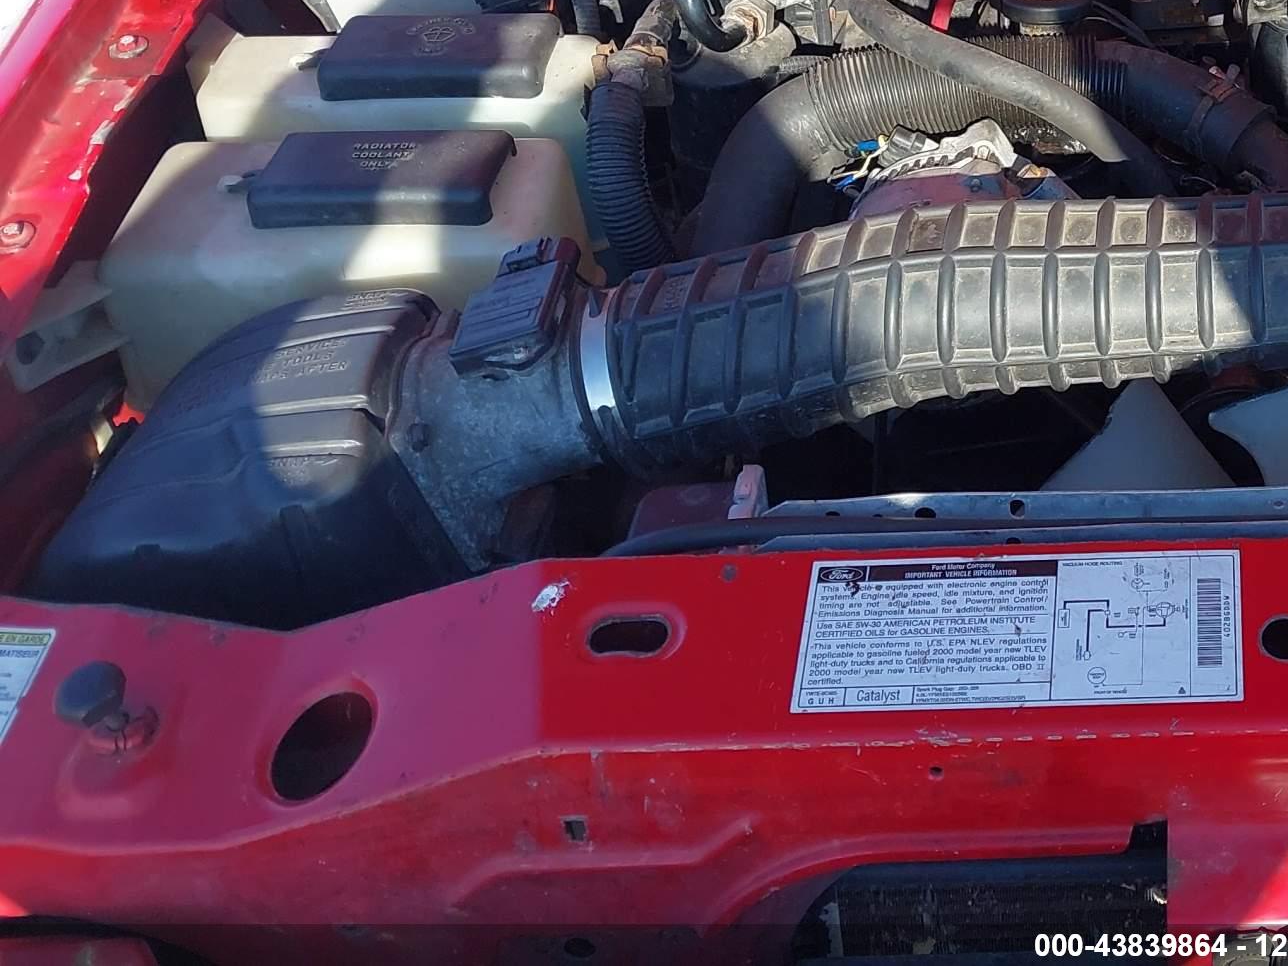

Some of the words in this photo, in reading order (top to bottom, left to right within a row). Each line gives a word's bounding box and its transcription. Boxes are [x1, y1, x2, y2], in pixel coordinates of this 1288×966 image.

[829, 570, 855, 580] Ford
[904, 571, 942, 579] IMPORTANT
[885, 582, 924, 591] equipped
[1021, 579, 1048, 587] control
[912, 590, 940, 599] speed,
[1019, 588, 1048, 596] ignition
[820, 602, 845, 610] timing
[1013, 595, 1048, 603] Control/
[864, 608, 904, 617] Diagnosis
[908, 606, 938, 614] Manual
[956, 605, 995, 613] additional
[999, 604, 1047, 612] information.
[835, 621, 853, 629] SAE
[883, 619, 931, 627] AMERICAN
[933, 618, 987, 626] PETROLEUM
[900, 627, 945, 635] GASOLINE
[19, 634, 46, 644] GARDE
[927, 639, 944, 647] U.S.
[949, 638, 966, 646] EPA
[970, 638, 995, 646] NLEV
[999, 637, 1047, 646] regulations
[811, 651, 853, 660] applicable
[867, 650, 902, 658] gasoline
[904, 648, 930, 656] fueled
[956, 647, 981, 655] model
[984, 647, 1001, 655] year
[810, 660, 848, 668] light-duty
[878, 658, 893, 666] and
[905, 656, 945, 665] California
[947, 656, 992, 664] regulations
[995, 655, 1035, 663] applicable
[864, 668, 884, 676] year
[936, 665, 976, 674] light-duty
[807, 678, 843, 686] certified.
[856, 689, 900, 703] Catalyst
